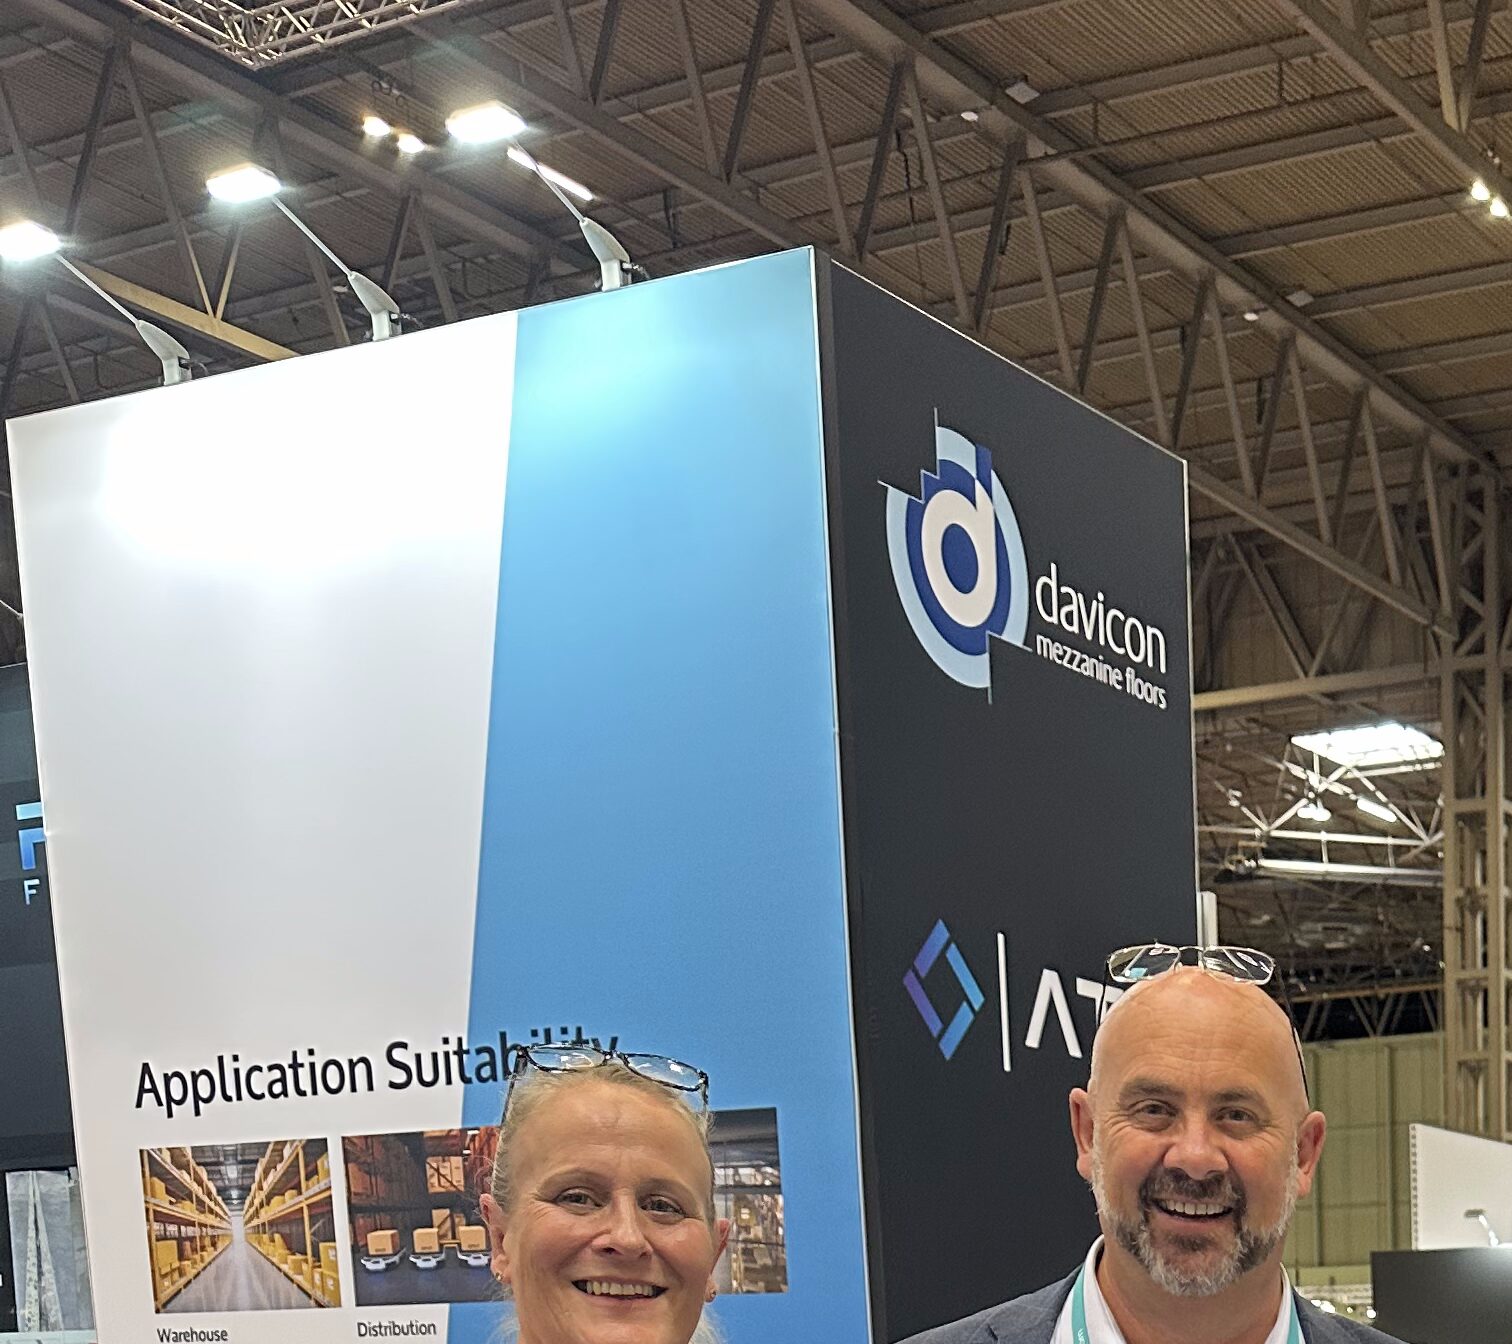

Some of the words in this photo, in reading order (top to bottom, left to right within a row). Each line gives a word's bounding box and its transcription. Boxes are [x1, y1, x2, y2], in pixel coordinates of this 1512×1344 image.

[1035, 562, 1167, 674] davicon
[1036, 634, 1124, 690] mezzanine
[1126, 666, 1167, 709] floors
[135, 1049, 374, 1119] Application
[386, 1026, 618, 1089] Suitab
[157, 1326, 229, 1343] Warehouse
[357, 1319, 437, 1337] Distribution
